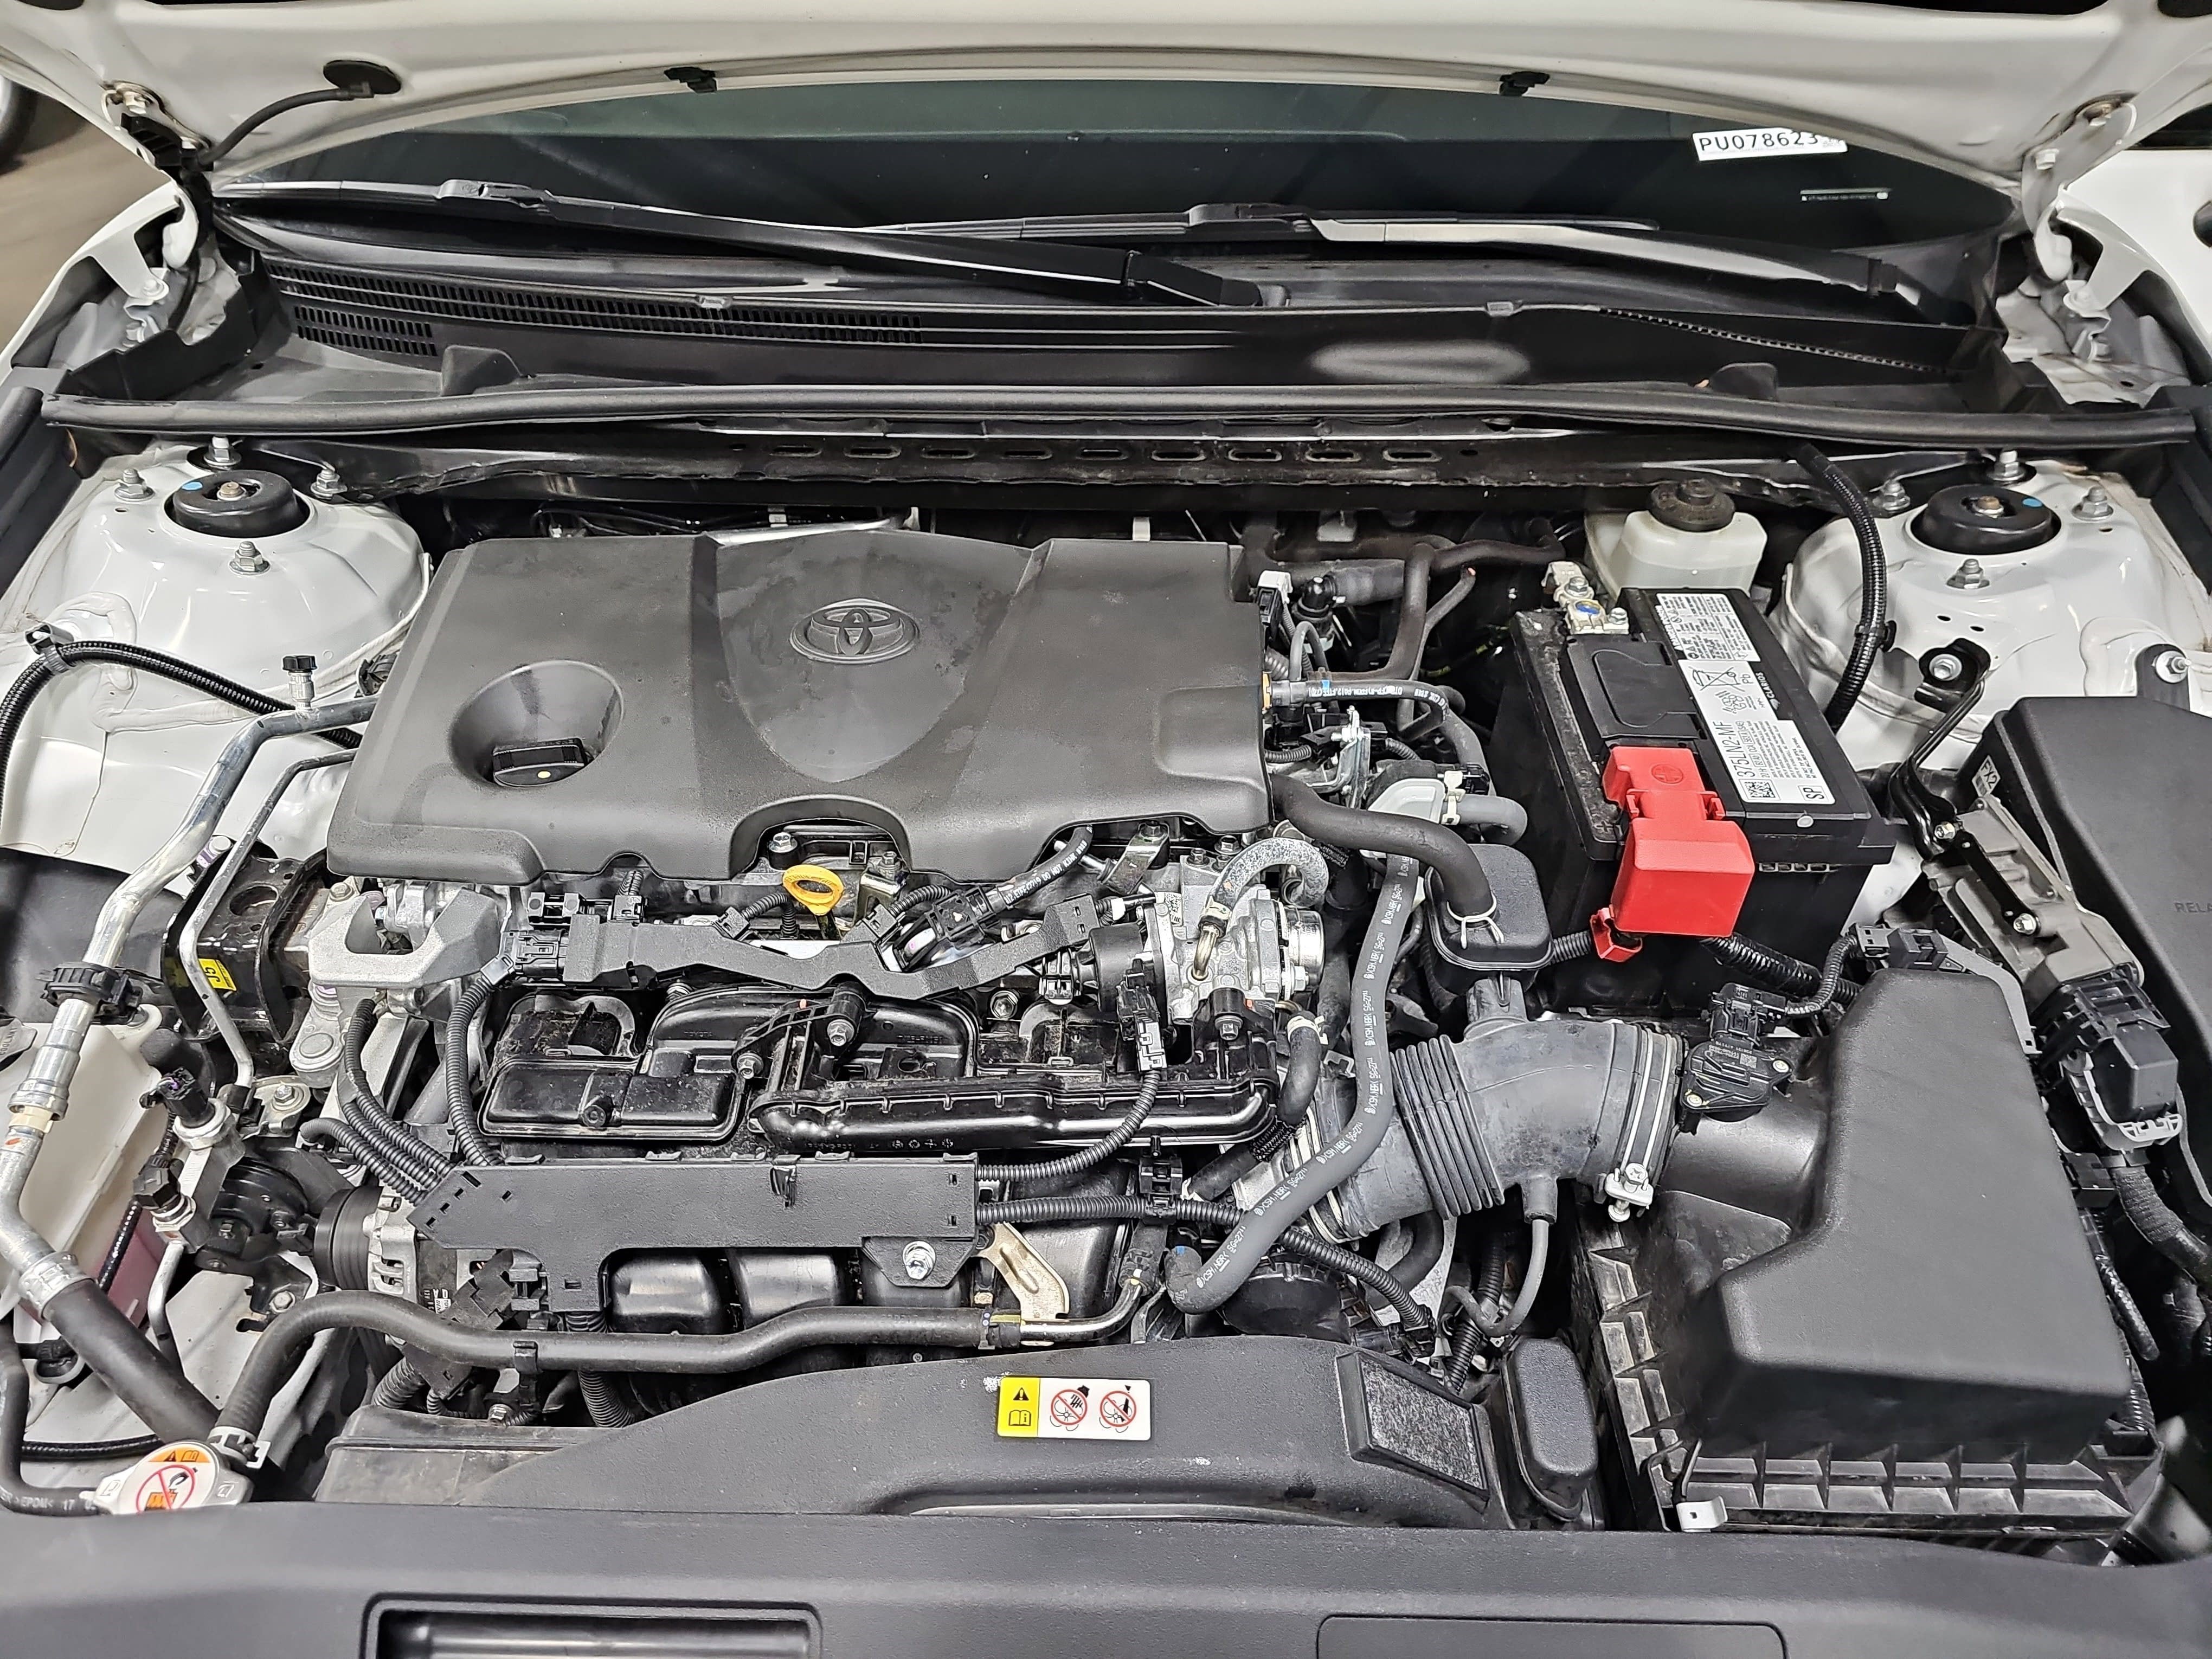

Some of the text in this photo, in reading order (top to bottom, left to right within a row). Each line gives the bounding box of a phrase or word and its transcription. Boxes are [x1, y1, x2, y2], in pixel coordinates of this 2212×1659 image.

[1699, 132, 1818, 151] PU078623
[1757, 672, 1776, 698] CLARIOS
[1713, 721, 1756, 777] 375LN2-MF
[1980, 759, 1998, 789] FX2
[1803, 787, 1825, 800] SP
[205, 967, 221, 982] J5
